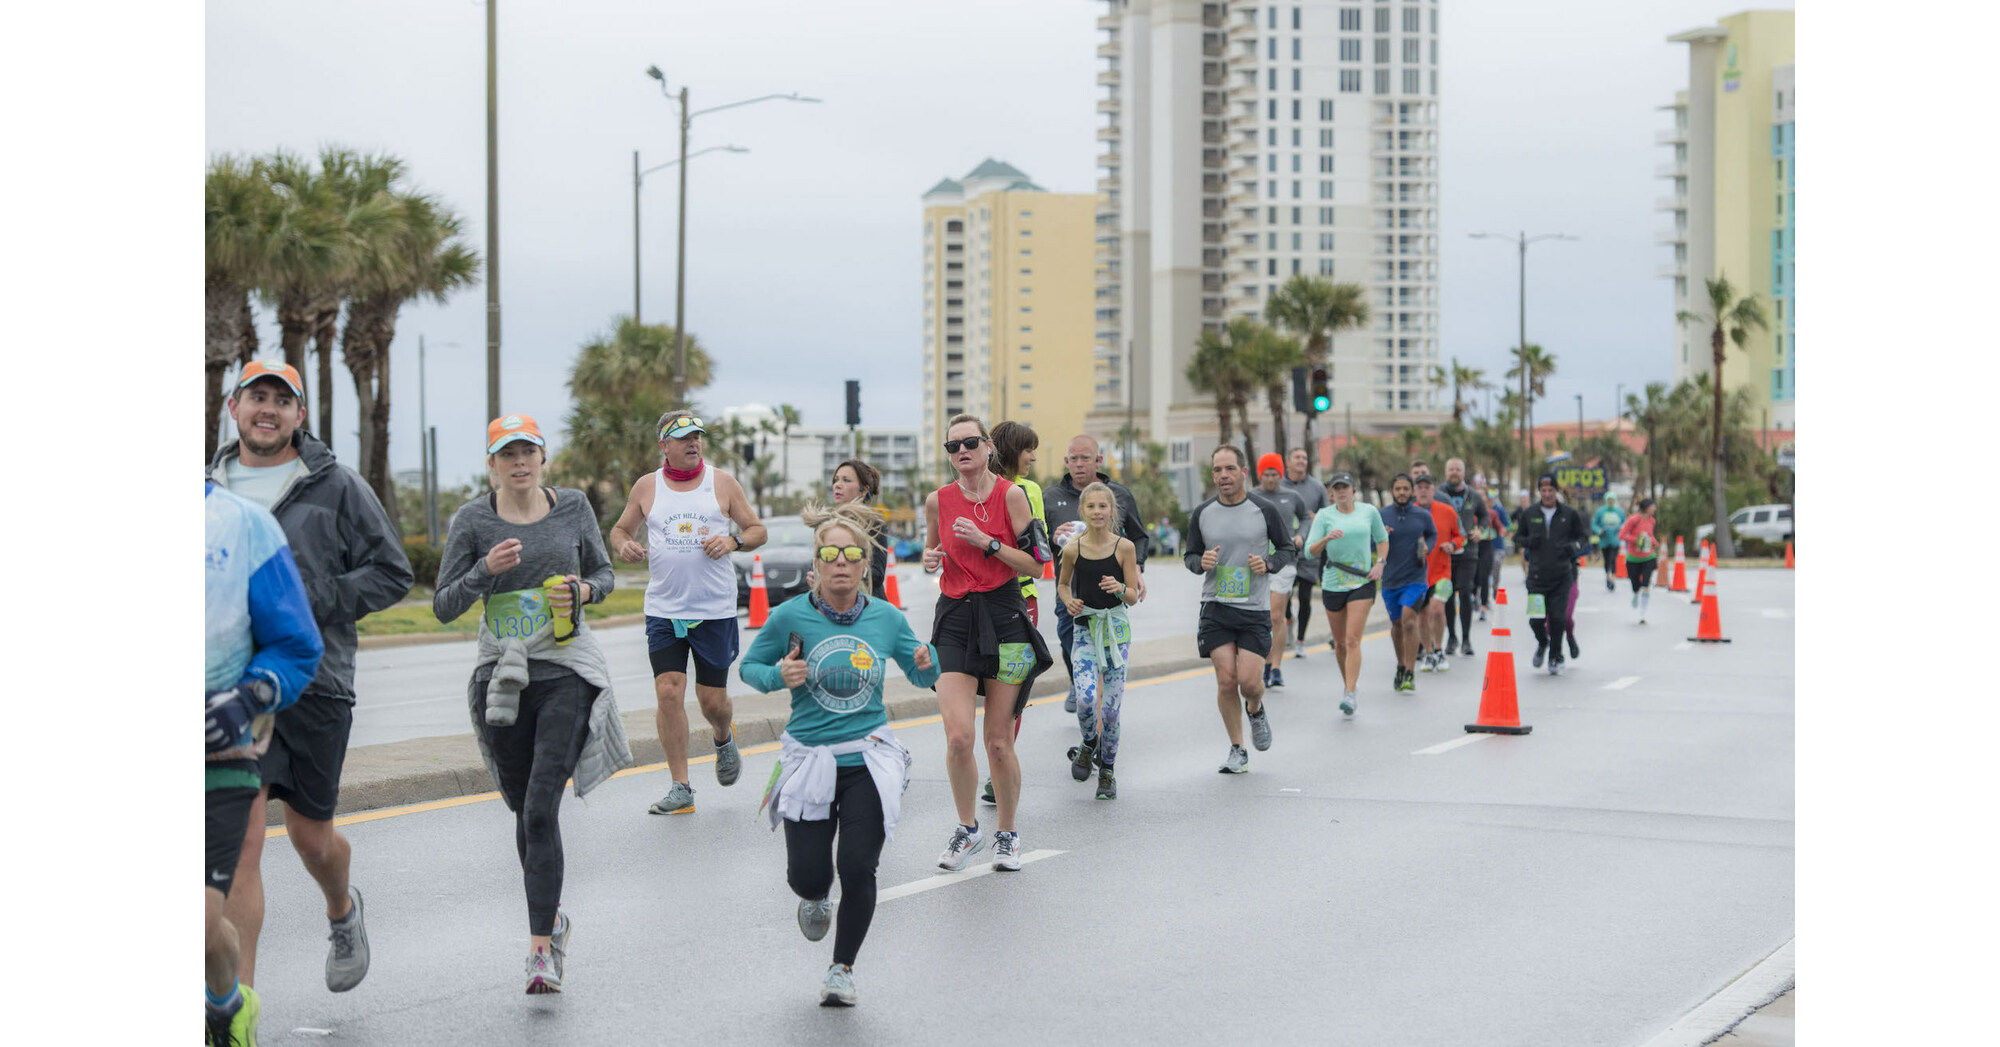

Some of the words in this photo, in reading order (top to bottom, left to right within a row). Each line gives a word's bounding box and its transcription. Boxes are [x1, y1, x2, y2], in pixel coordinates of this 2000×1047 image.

[683, 512, 698, 520] HILL
[1219, 580, 1244, 595] 934
[493, 614, 548, 639] 1302
